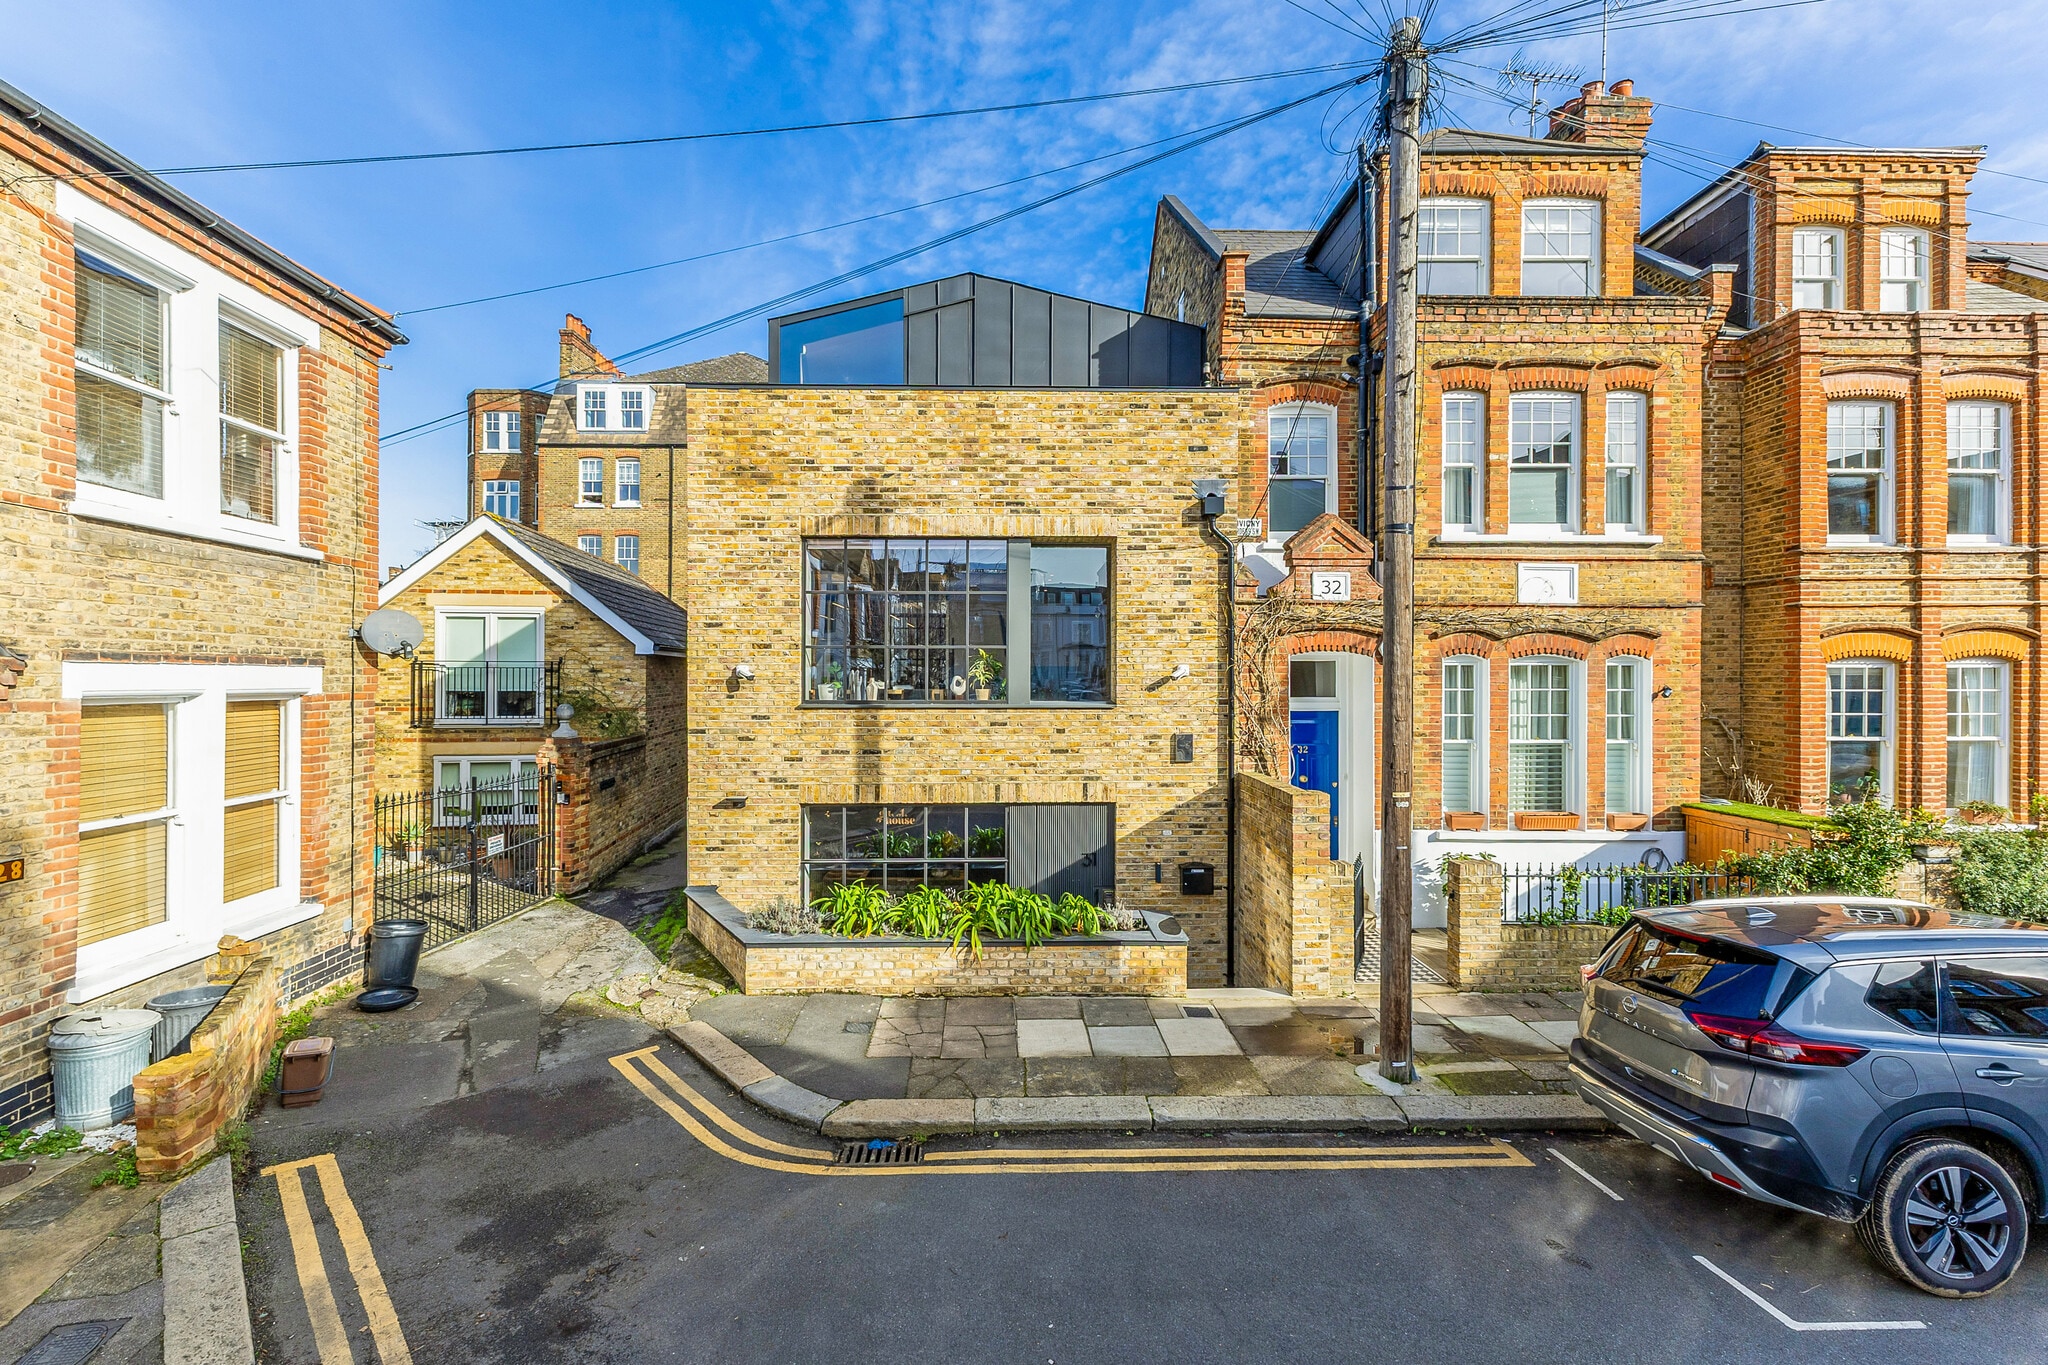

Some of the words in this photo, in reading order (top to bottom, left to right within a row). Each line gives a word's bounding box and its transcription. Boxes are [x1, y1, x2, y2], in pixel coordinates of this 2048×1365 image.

[1321, 580, 1342, 595] 32
[1297, 745, 1309, 754] 32
[1081, 852, 1097, 867] 31
[0, 860, 22, 882] 28
[1603, 1007, 1658, 1036] X-TRAIL
